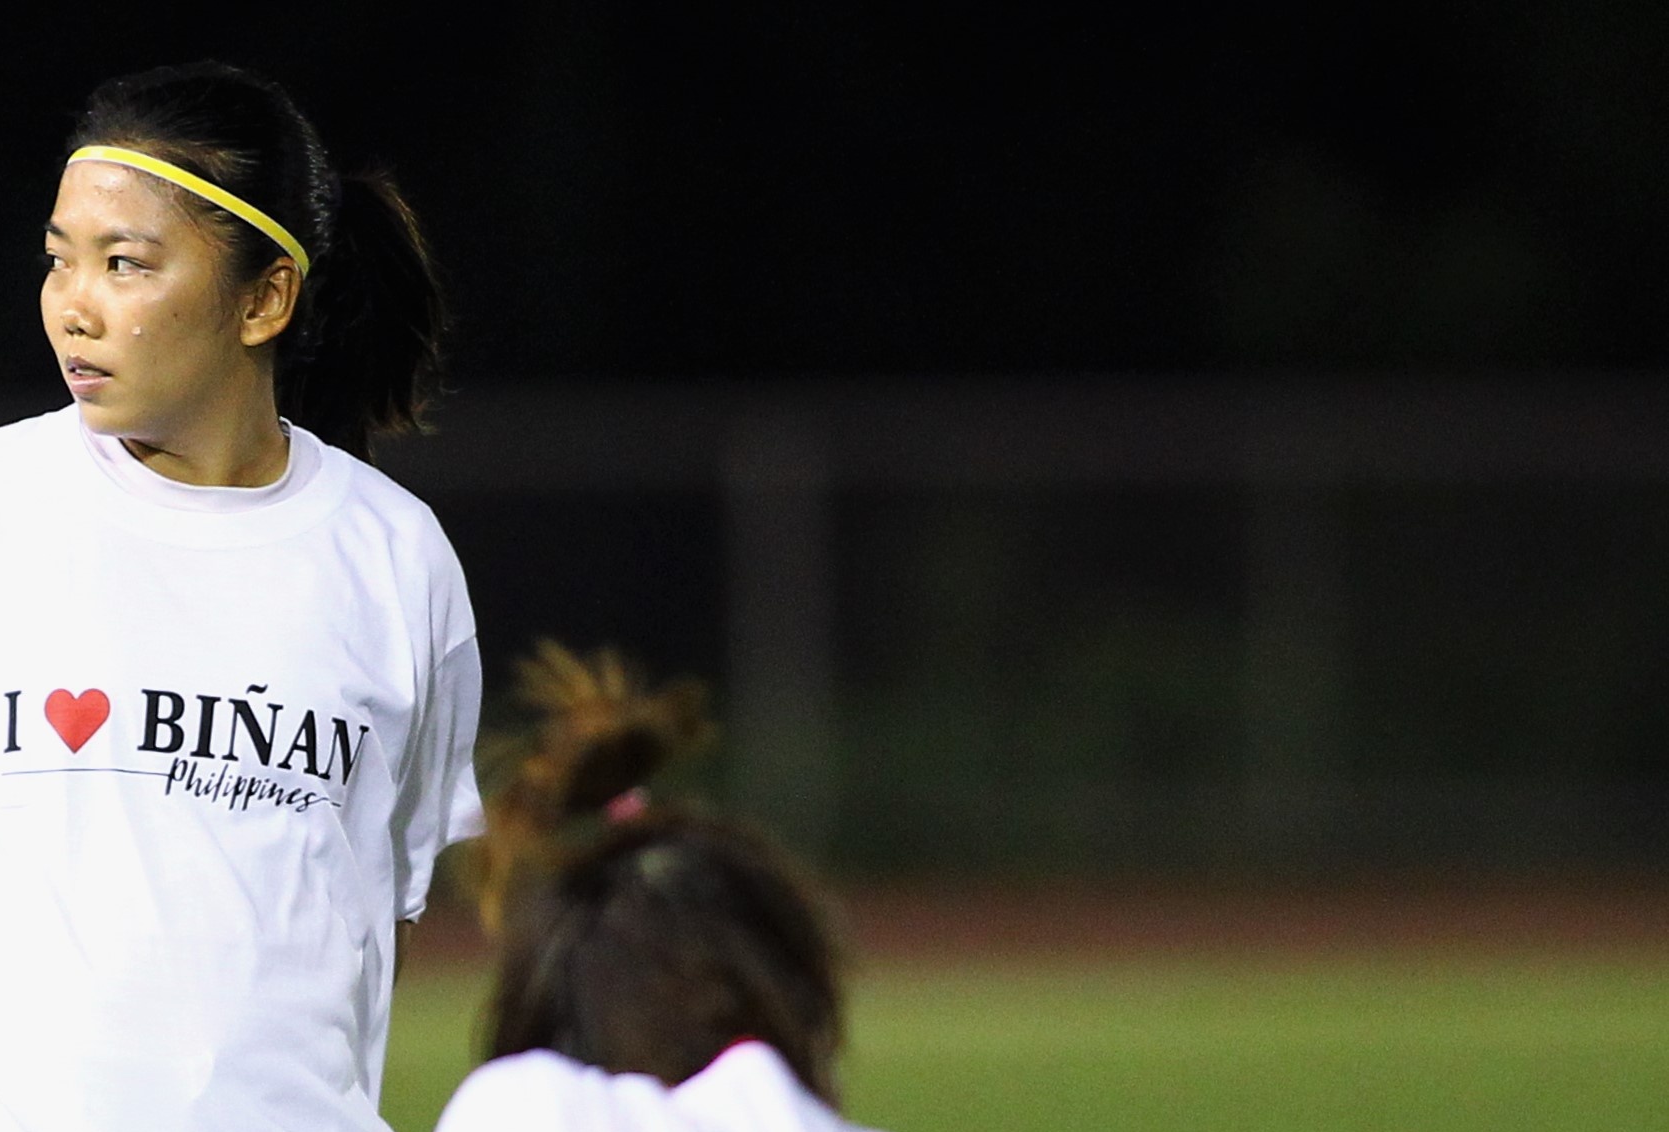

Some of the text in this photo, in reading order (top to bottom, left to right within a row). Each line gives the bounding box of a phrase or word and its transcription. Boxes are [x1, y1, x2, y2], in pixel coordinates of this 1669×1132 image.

[3, 684, 370, 785] I BIÑAN
[165, 757, 333, 813] Philippines
